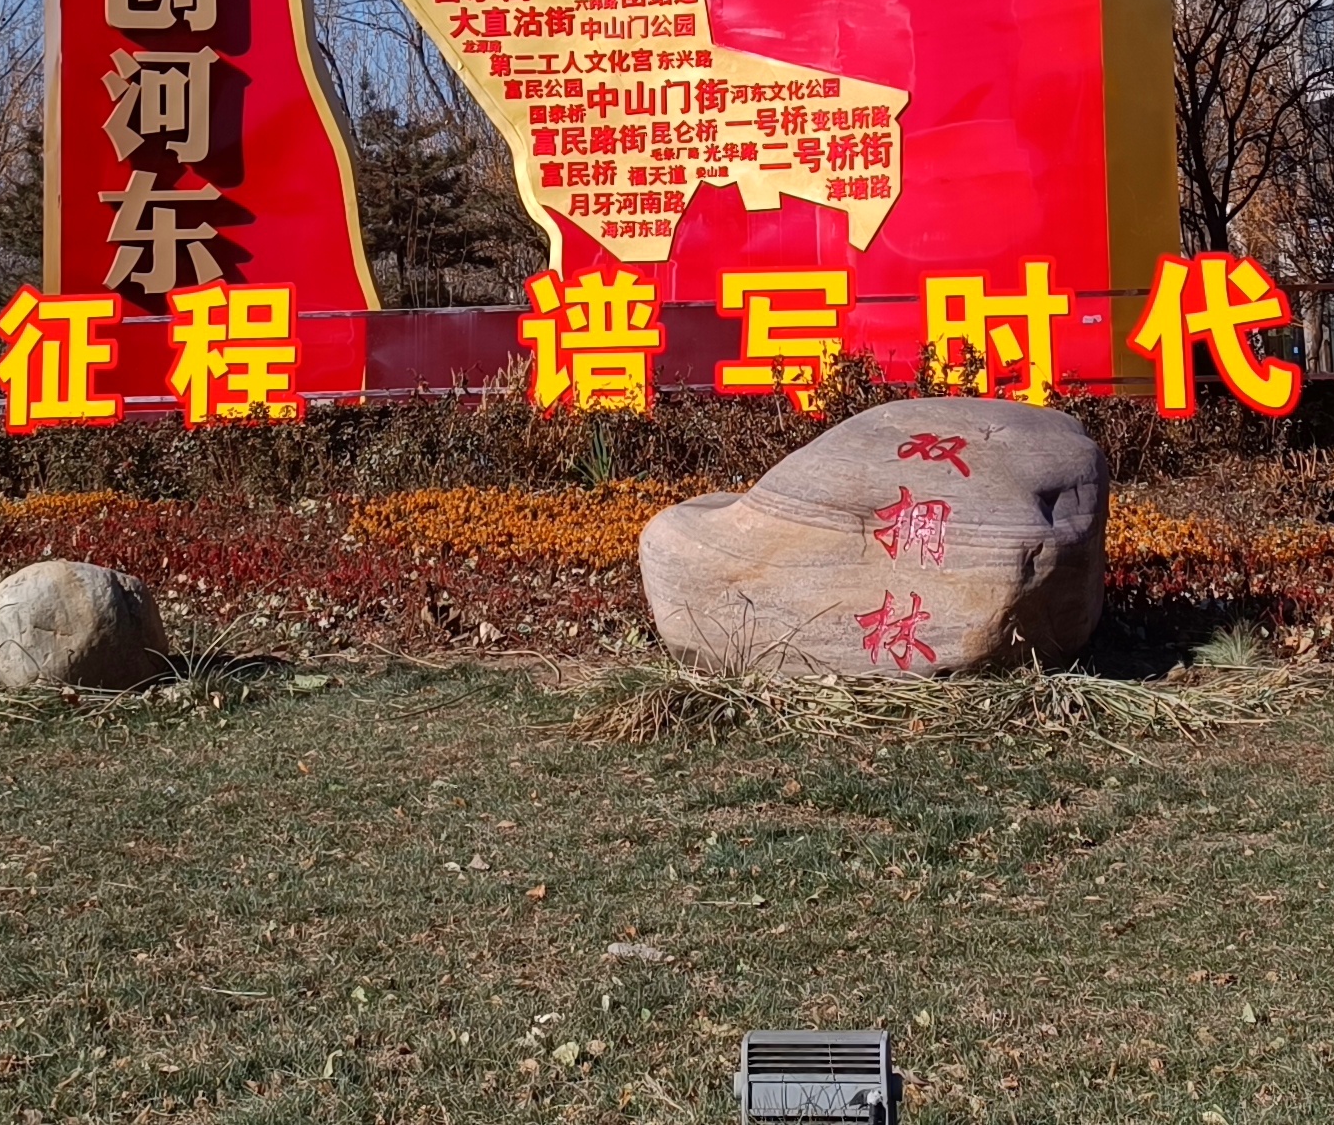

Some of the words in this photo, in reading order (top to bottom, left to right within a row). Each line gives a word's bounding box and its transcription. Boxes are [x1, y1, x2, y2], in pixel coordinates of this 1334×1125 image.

[449, 6, 576, 39] 大直沽街
[580, 13, 696, 41] 中山门公园
[489, 48, 653, 77] 第二工人文化宫
[657, 49, 713, 71] 东兴路
[504, 78, 584, 100] 富民公园
[586, 78, 729, 118] 中山门街
[730, 77, 840, 105] 河东文化公园
[529, 103, 587, 125] 国泰桥
[725, 105, 809, 137] 一号桥
[811, 105, 892, 133] 变电所路
[531, 124, 648, 157] 富民路街
[651, 118, 718, 145] 昆仑桥
[703, 141, 759, 162] 光华路
[759, 131, 893, 174] 二号桥街
[540, 159, 617, 188] 富民桥
[627, 164, 687, 186] 福天道
[825, 174, 891, 201] 津塘路
[568, 190, 685, 217] 月牙河南路
[600, 219, 672, 238] 海河东路
[854, 432, 970, 671] 双拥林
